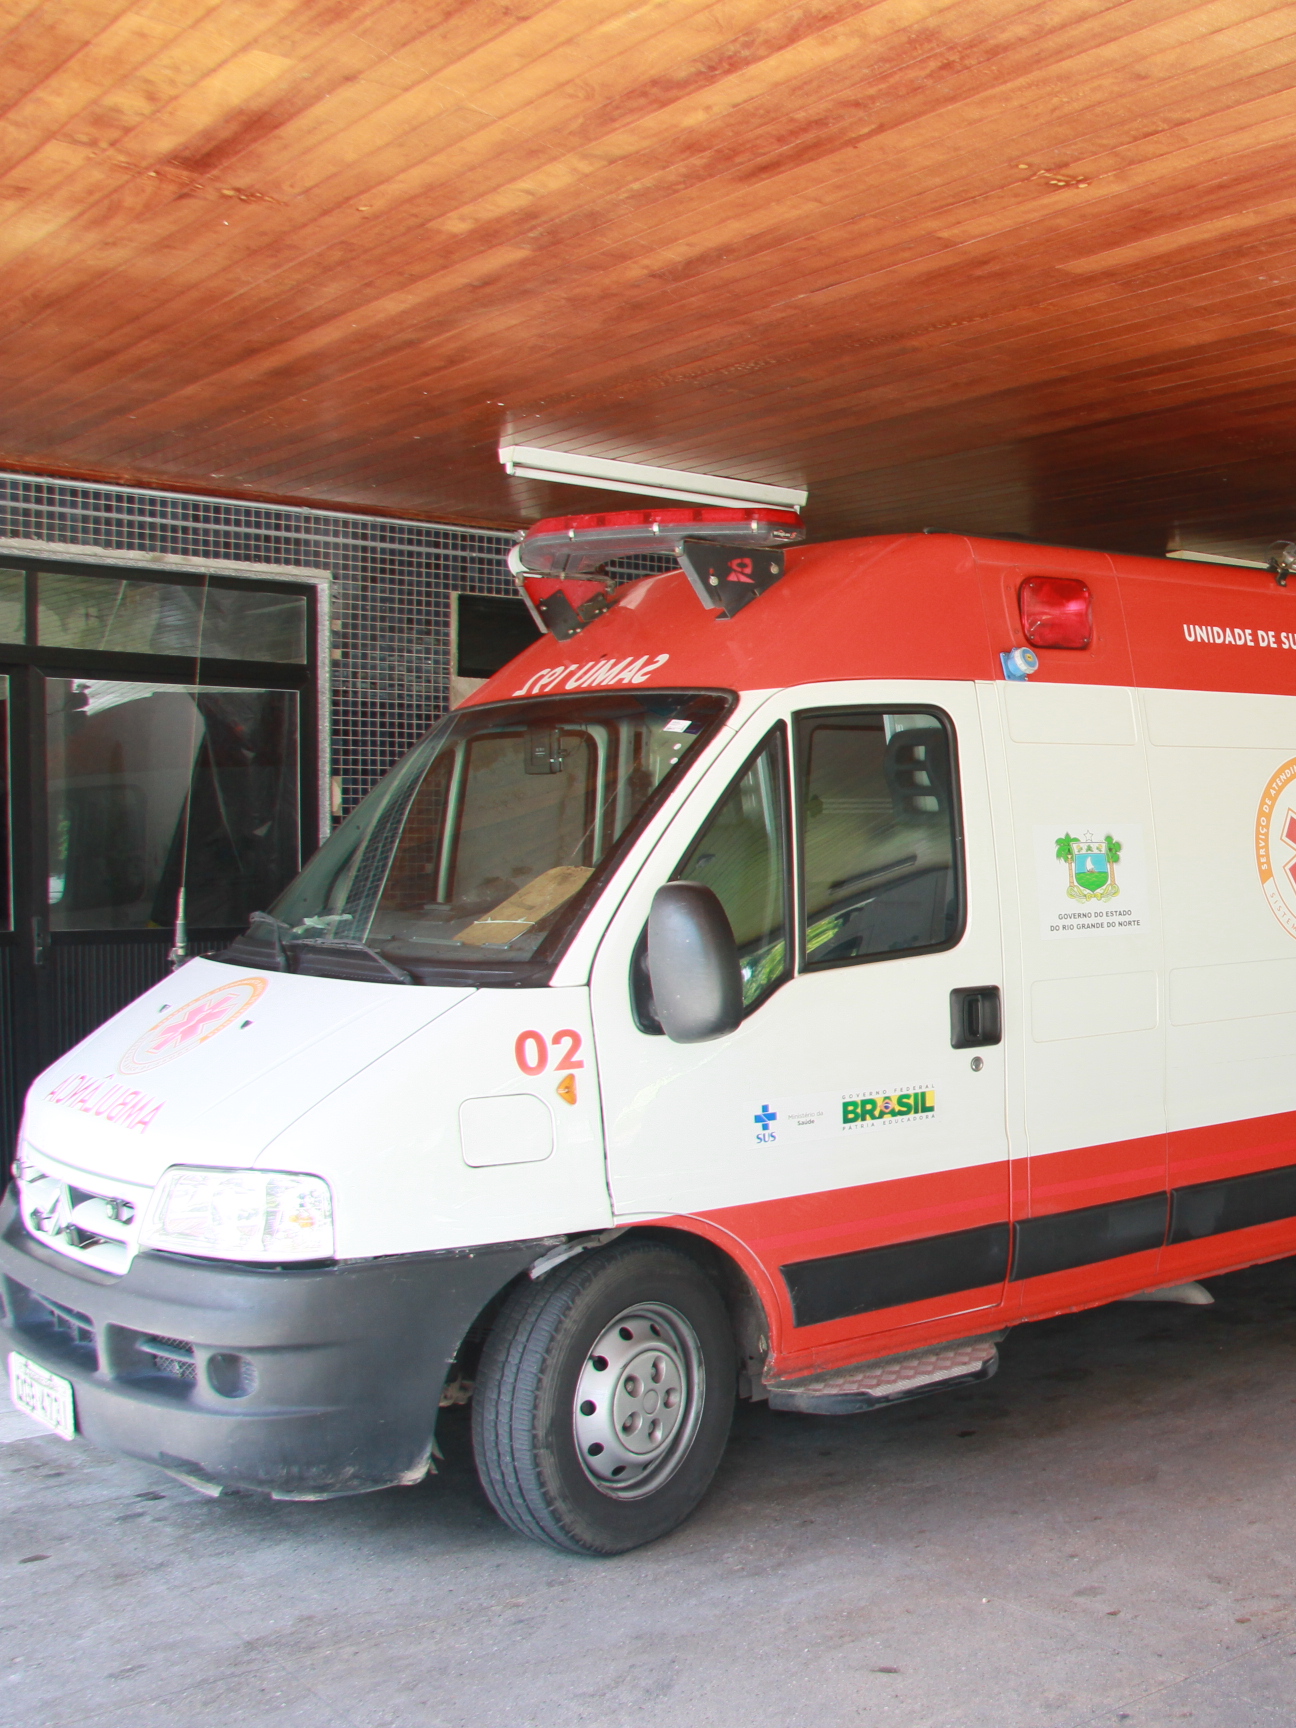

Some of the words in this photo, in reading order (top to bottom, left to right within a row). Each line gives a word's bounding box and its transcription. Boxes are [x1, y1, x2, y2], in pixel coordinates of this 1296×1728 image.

[1182, 624, 1254, 646] UNIDADE
[1257, 630, 1278, 648] DE
[1263, 798, 1272, 813] DE
[1259, 816, 1268, 870] SERVIÇO
[1058, 911, 1092, 920] GOVERNO
[1105, 909, 1132, 918] ESTADO
[1076, 922, 1105, 930] GRANDE
[515, 1029, 584, 1076] 02
[842, 1089, 887, 1100] GOVERNO
[894, 1083, 936, 1094] FEDERAL
[787, 1111, 816, 1120] Ministério
[842, 1091, 935, 1125] BRASIL
[797, 1118, 815, 1126] Saúde
[842, 1121, 876, 1131] PÁTRIA
[882, 1113, 936, 1126] EDUCADORA
[756, 1131, 777, 1144] SUS
